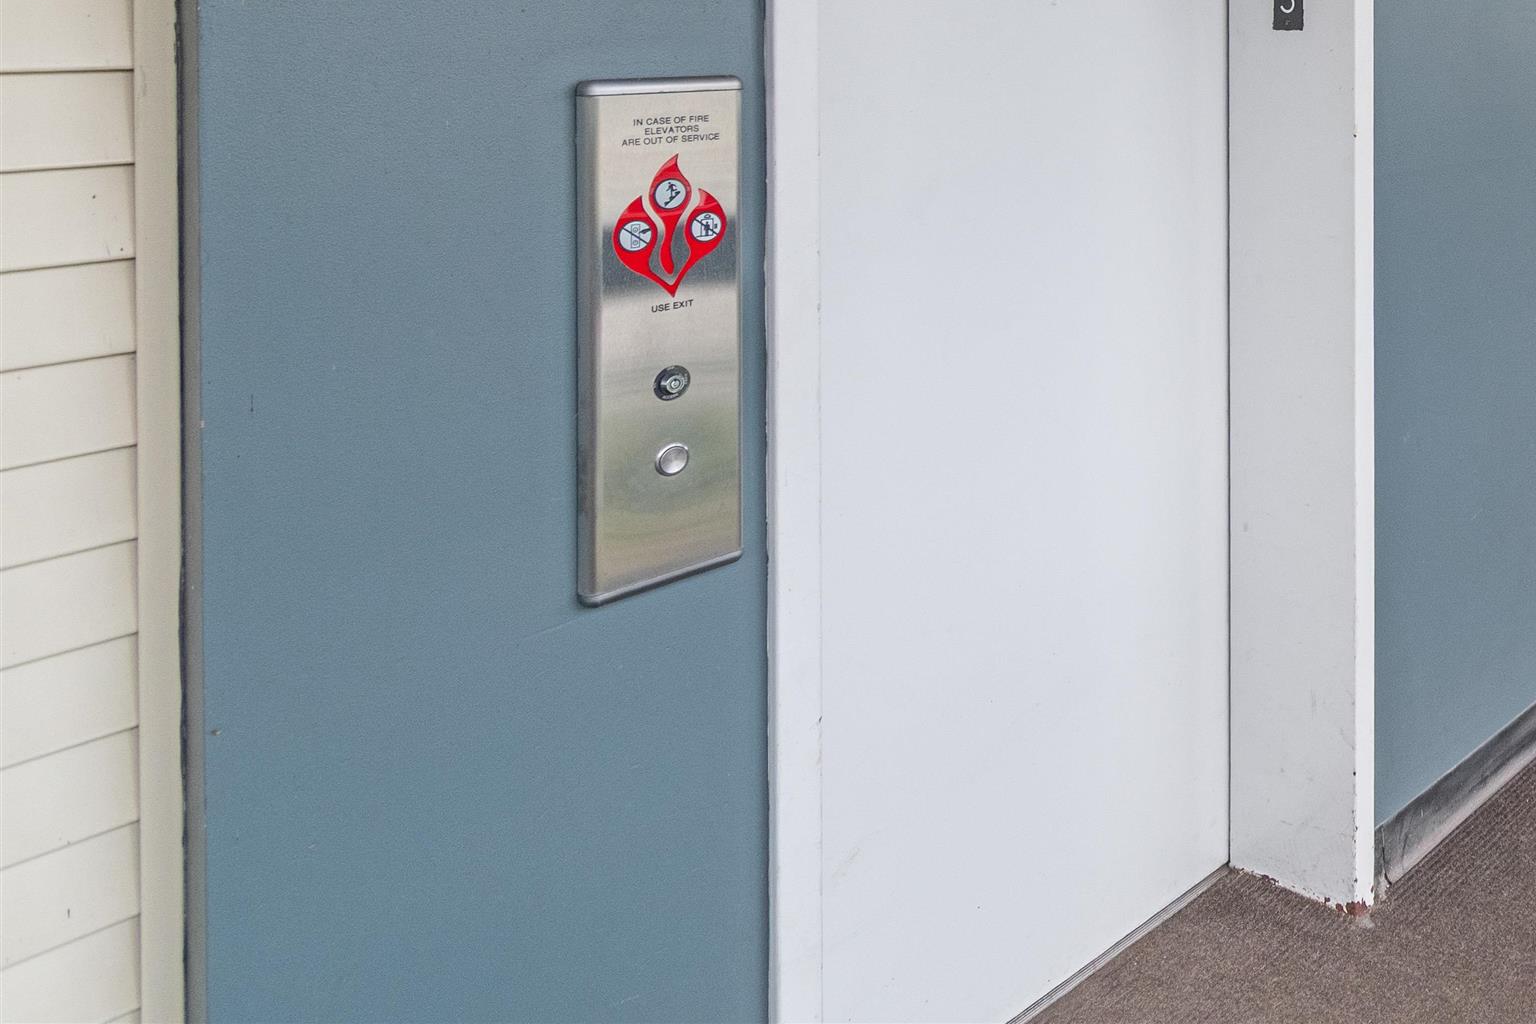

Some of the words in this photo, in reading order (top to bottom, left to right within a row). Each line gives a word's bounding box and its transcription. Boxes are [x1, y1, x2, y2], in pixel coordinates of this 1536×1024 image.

[633, 118, 643, 126] IN
[646, 116, 672, 126] CASE
[673, 115, 687, 124] OF
[689, 114, 710, 123] FIRE
[644, 124, 700, 136] ELEVATORS
[621, 138, 641, 147] ARE
[643, 136, 663, 145] OUT
[665, 135, 679, 144] OF
[681, 132, 720, 143] SERVICE
[651, 303, 671, 313] USE
[673, 298, 694, 310] EXIT
